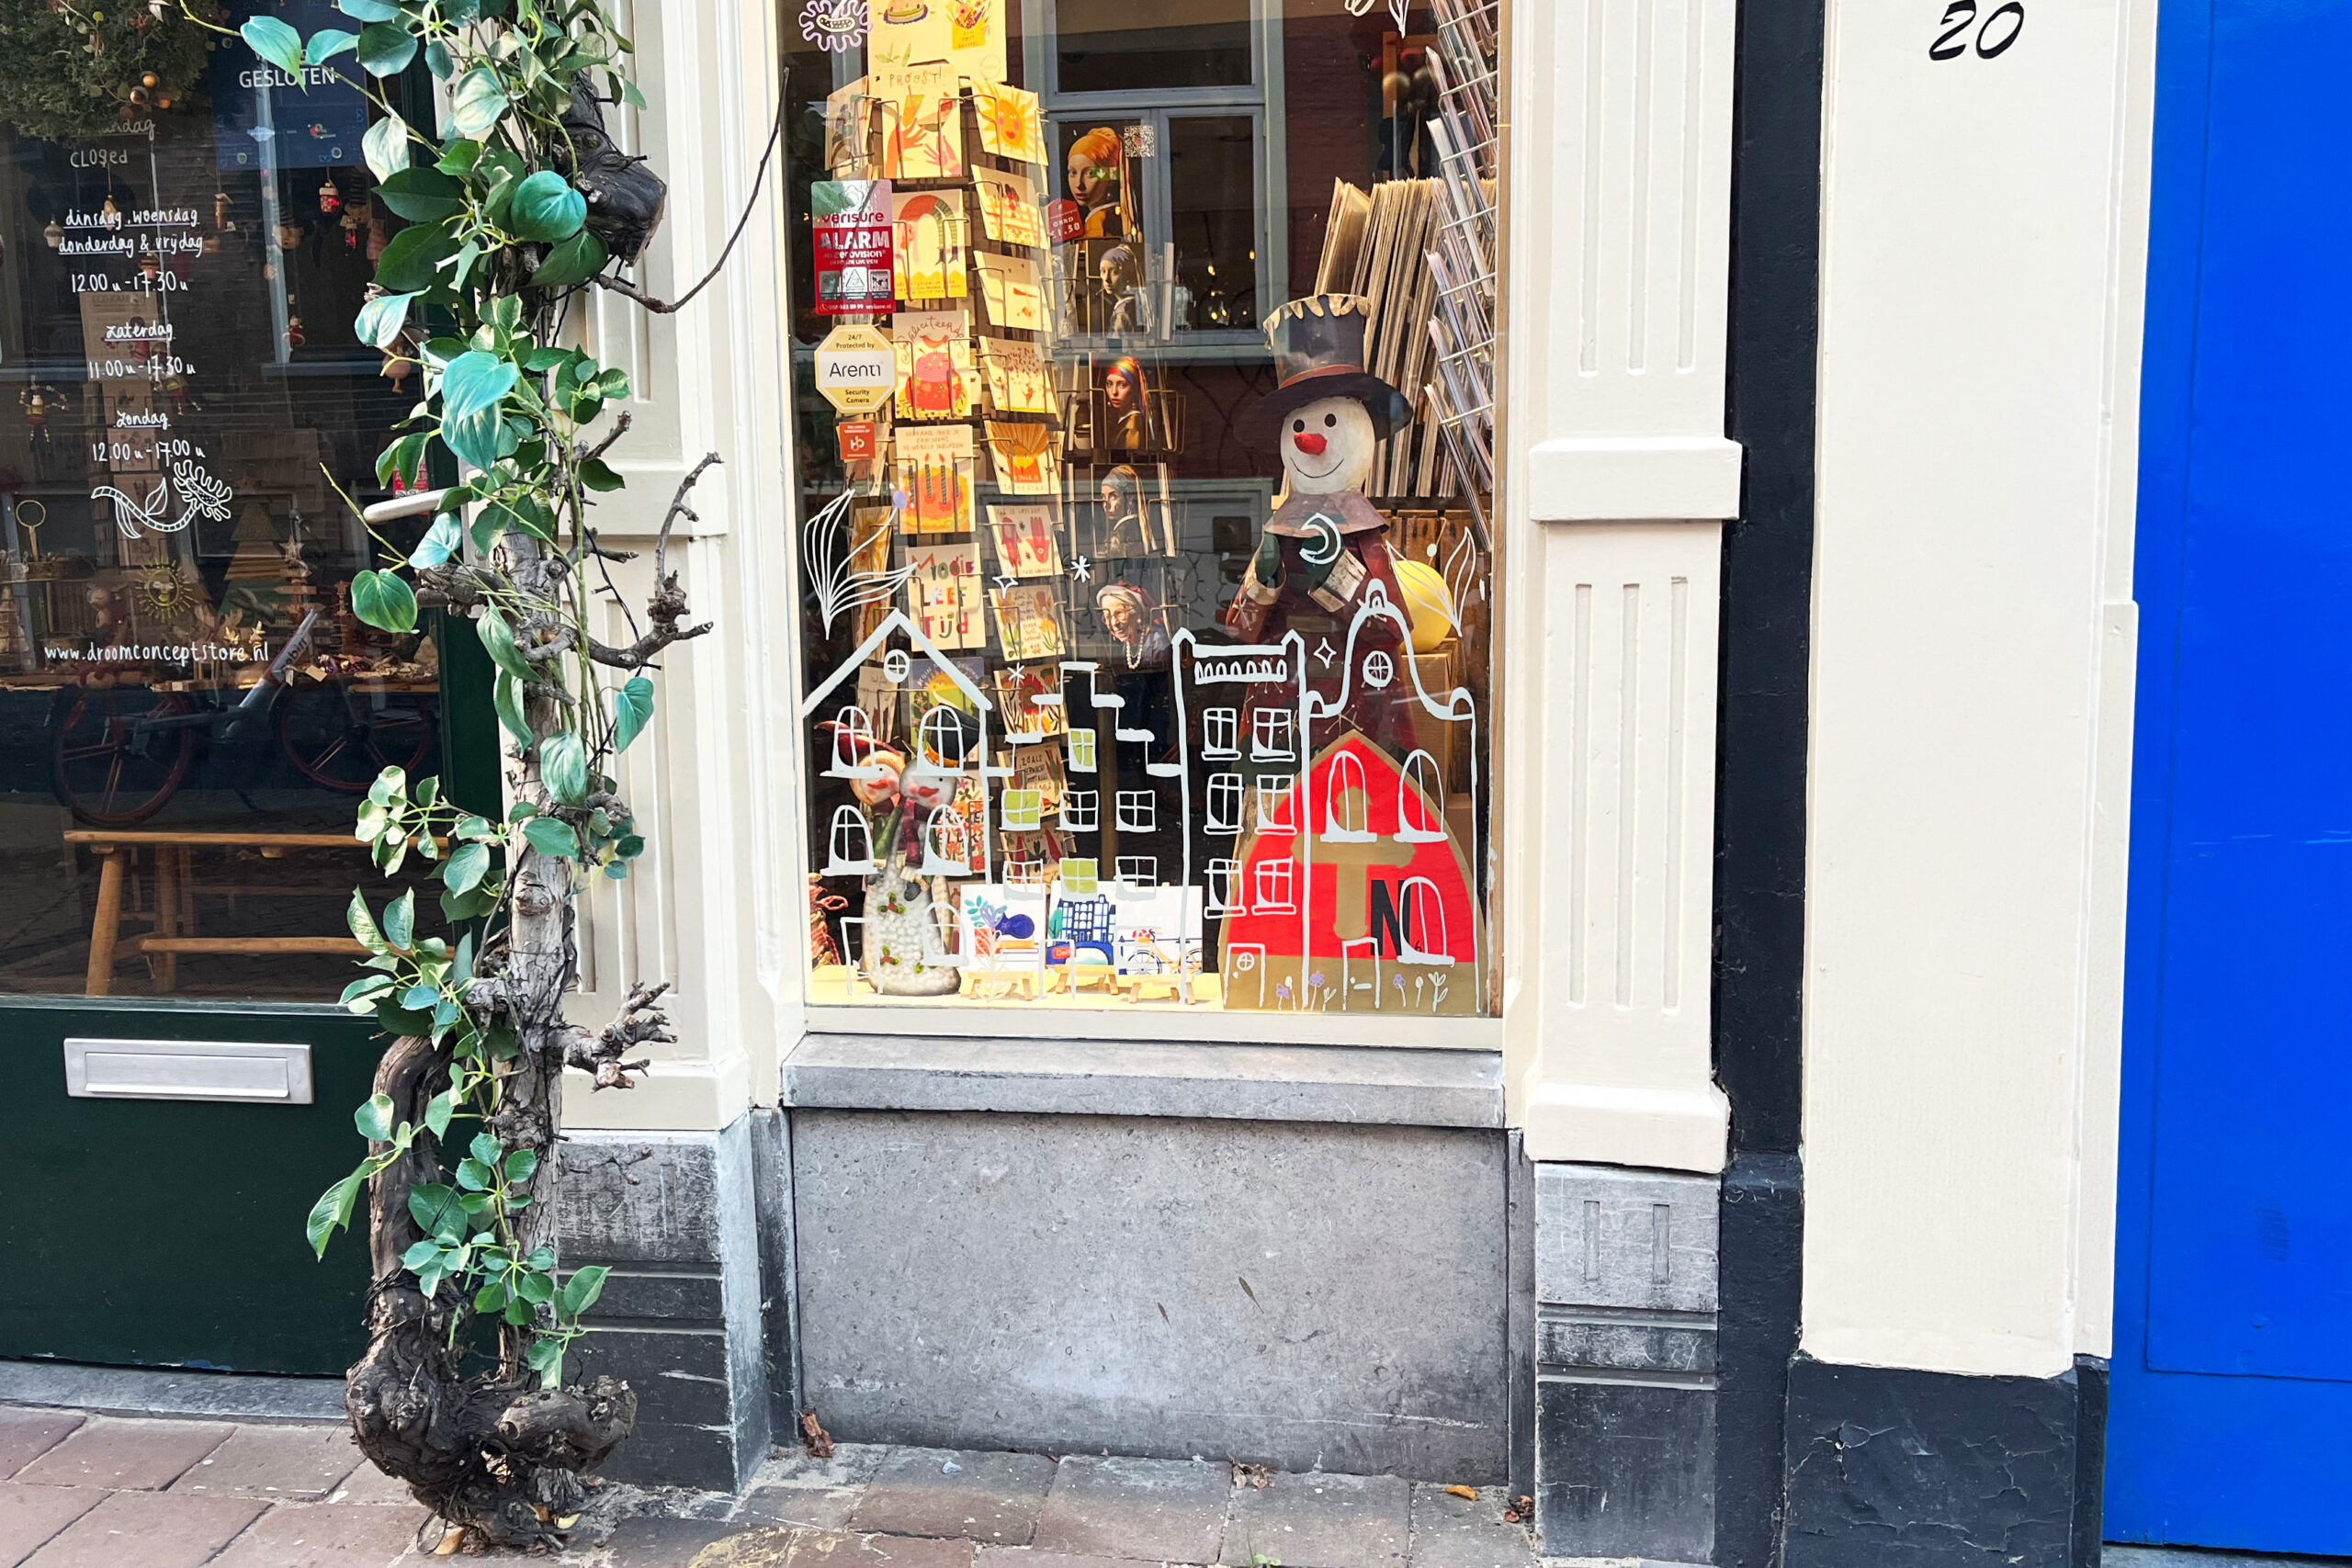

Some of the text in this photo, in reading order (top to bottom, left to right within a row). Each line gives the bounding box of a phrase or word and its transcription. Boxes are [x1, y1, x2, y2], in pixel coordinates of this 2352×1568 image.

[1928, 0, 2024, 61] 20
[820, 212, 885, 223] verisure
[59, 235, 133, 258] donderdag
[140, 233, 150, 251] &
[820, 231, 890, 250] ALARM
[72, 273, 107, 292] 12.00
[92, 442, 130, 461] 12.00
[43, 641, 269, 668] www.droomconceptstore.nl
